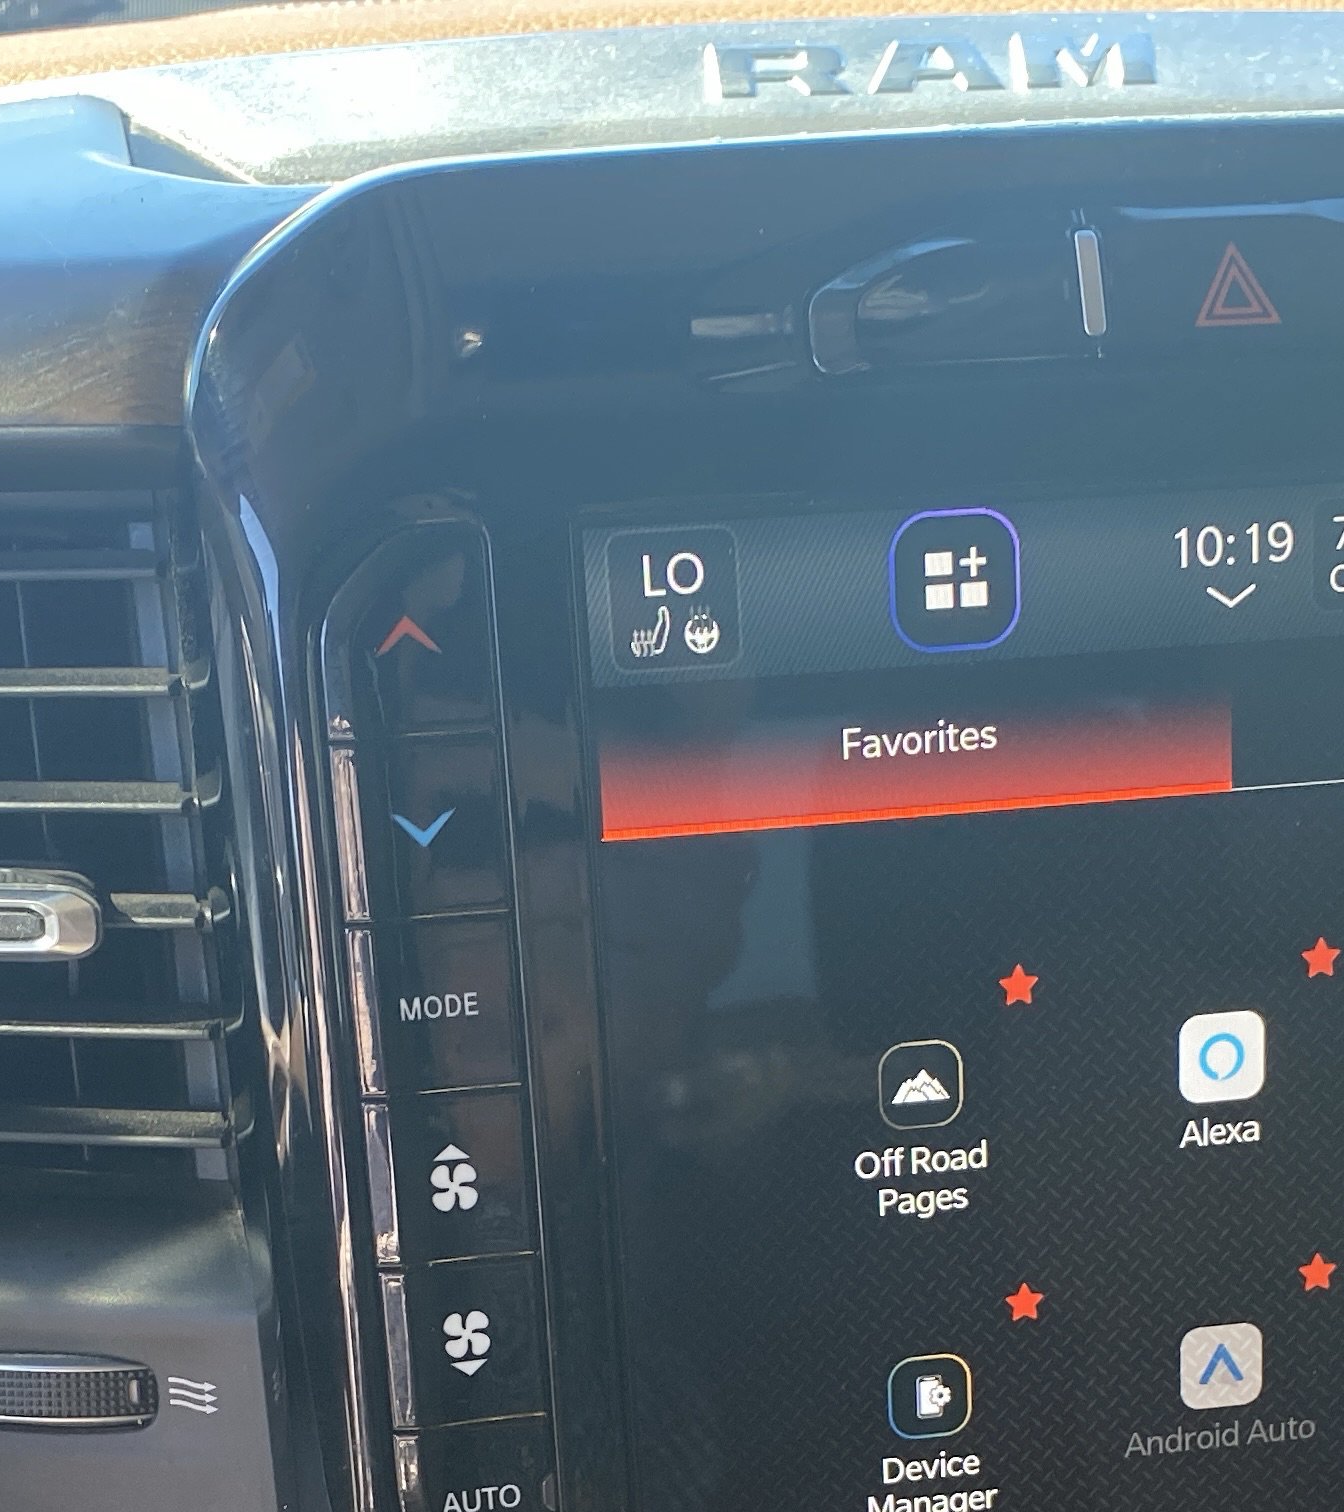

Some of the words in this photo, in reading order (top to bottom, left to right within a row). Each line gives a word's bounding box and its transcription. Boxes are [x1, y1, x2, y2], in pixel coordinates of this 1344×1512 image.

[702, 32, 1156, 103] RAM
[1172, 520, 1295, 569] 10:19
[641, 551, 705, 598] LO
[840, 718, 998, 761] Favorites
[399, 991, 480, 1022] MODE
[1179, 1116, 1261, 1149] Alexa
[854, 1146, 905, 1181] Off
[911, 1138, 989, 1174] Road
[878, 1183, 970, 1219] Pages
[1124, 1419, 1240, 1458] Android
[1246, 1415, 1316, 1444] Auto
[881, 1450, 981, 1485] Device
